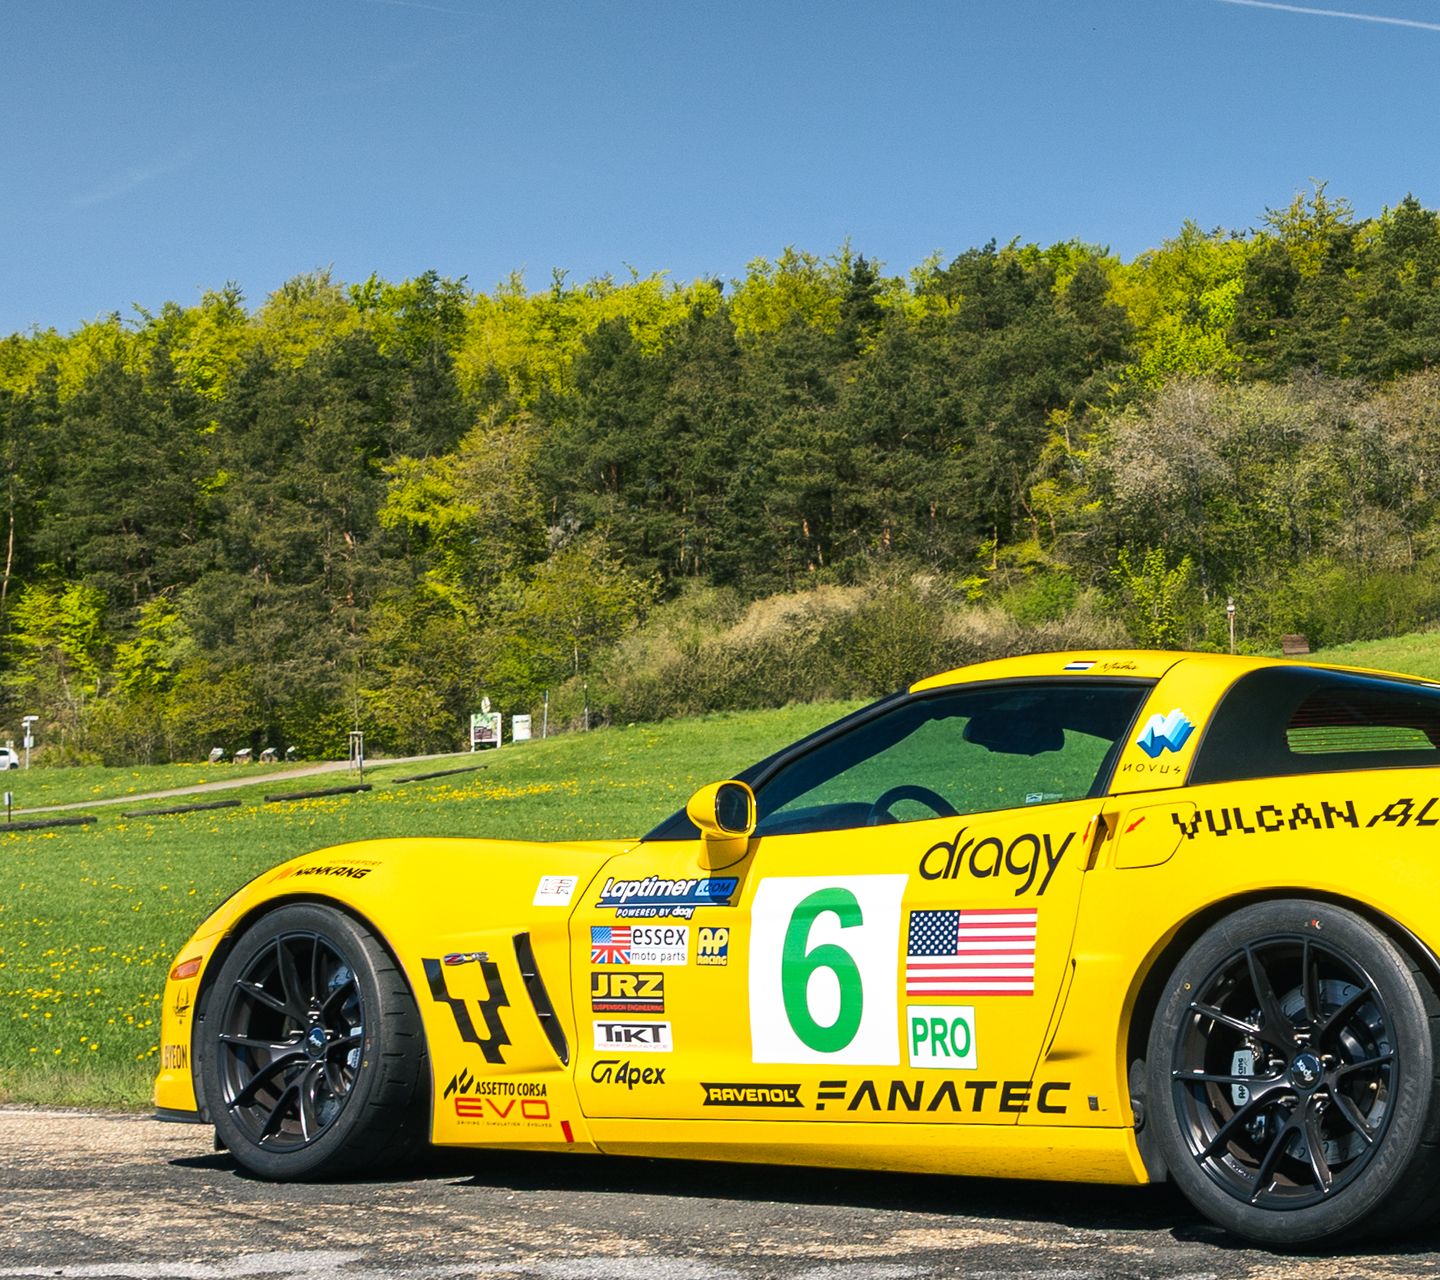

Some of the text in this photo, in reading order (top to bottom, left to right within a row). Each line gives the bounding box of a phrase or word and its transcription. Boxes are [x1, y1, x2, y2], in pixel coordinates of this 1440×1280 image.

[1171, 799, 1360, 840] VULCAN
[918, 826, 1077, 897] dragy
[616, 907, 656, 918] POWERED
[658, 907, 672, 917] BY
[633, 928, 686, 946] essex
[697, 928, 730, 956] AP
[631, 951, 686, 963] moto parts
[782, 887, 863, 1053] 6
[591, 974, 664, 998] JRZ
[911, 1017, 971, 1058] PRO
[474, 1081, 548, 1097] ASSETTO CORSA
[709, 1087, 795, 1103] RAVENOL
[815, 1079, 1072, 1115] FANATEC
[455, 1097, 550, 1120] EVO
